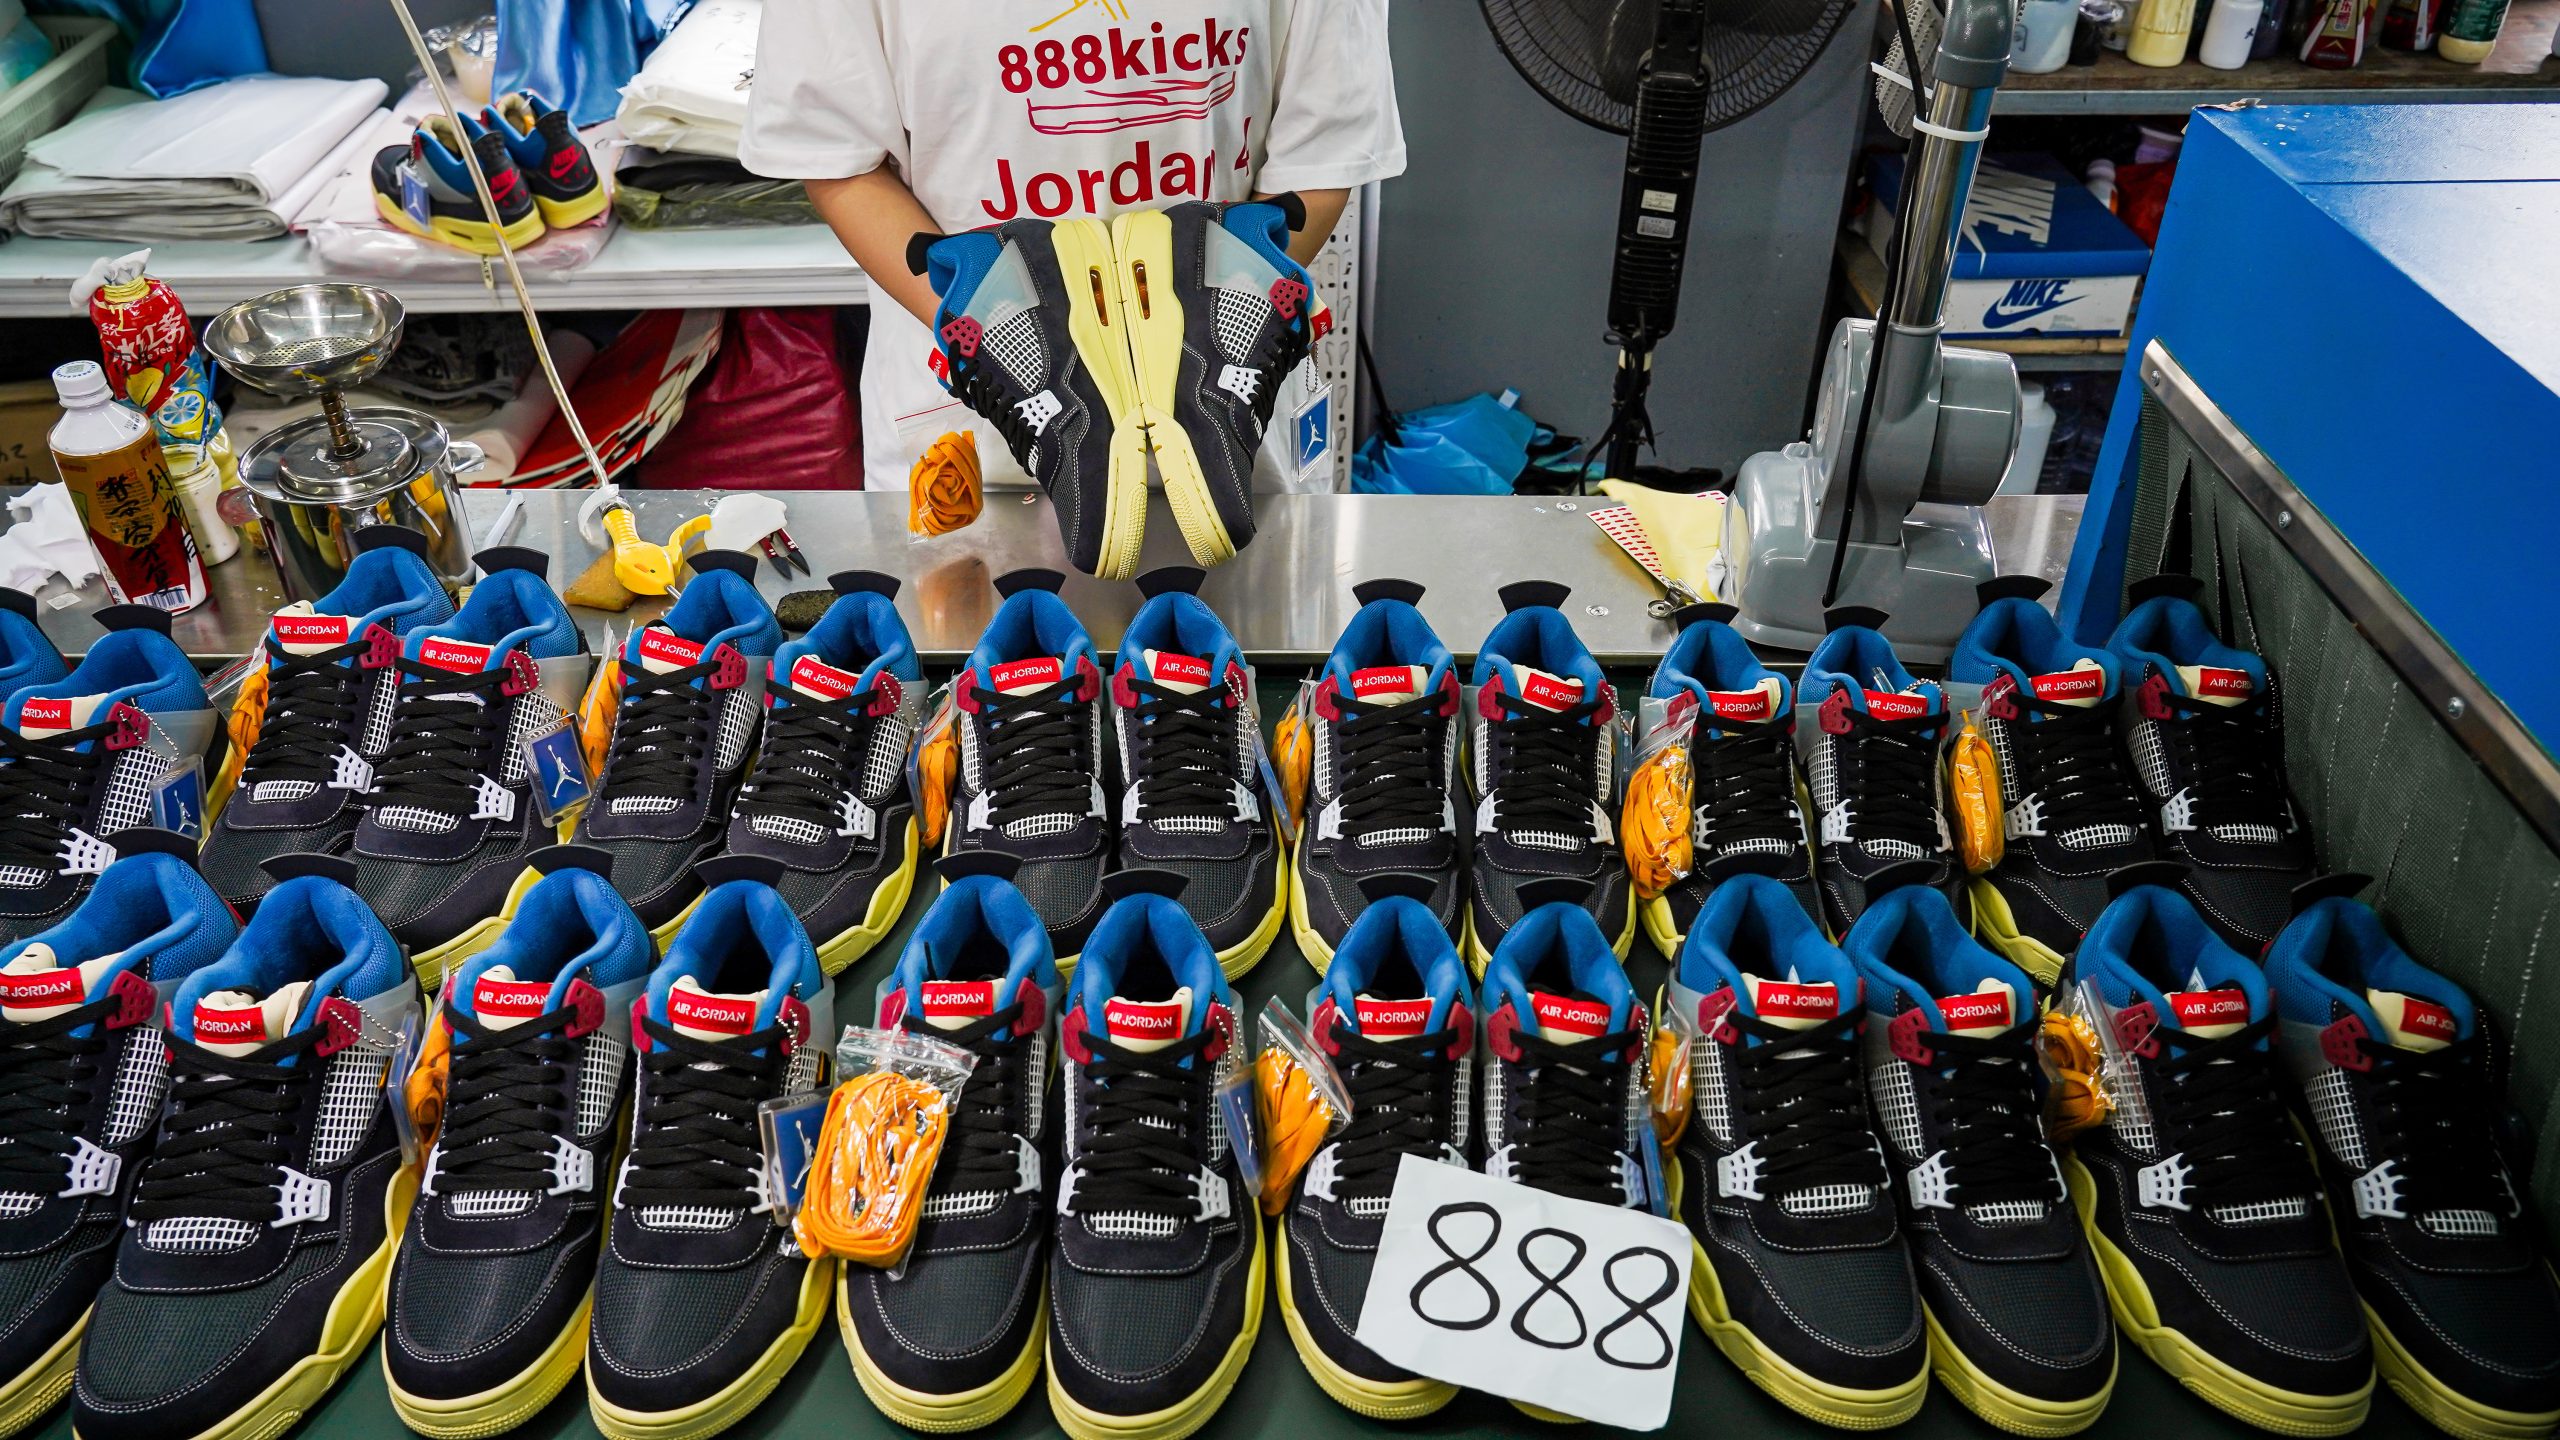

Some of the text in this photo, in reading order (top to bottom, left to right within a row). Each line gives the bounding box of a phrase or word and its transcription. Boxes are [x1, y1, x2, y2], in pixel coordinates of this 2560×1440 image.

[998, 17, 1251, 94] 888kicks
[1234, 116, 1252, 178] 4
[2001, 279, 2071, 307] NIKE
[153, 345, 174, 356] Tea
[279, 625, 340, 635] AIR JORDAN
[646, 639, 661, 650] AIR
[424, 648, 482, 665] AIR JORDAN
[994, 665, 1053, 684] AIR JORDAN
[1162, 662, 1180, 673] AIR
[798, 666, 854, 693] AIR JORDAN
[1364, 675, 1405, 686] JORDAN
[2037, 678, 2096, 692] AIR JORDAN
[2209, 677, 2228, 688] AIR
[1532, 684, 1550, 697] AIR
[1712, 701, 1764, 712] IR JORDAN
[1866, 699, 1923, 715] AIR JORDAN
[11, 980, 71, 998] JORDAN
[478, 990, 494, 1004] AIR
[932, 992, 985, 1005] JORDAN
[1767, 993, 1833, 1008] AIR JORDAN
[674, 1001, 746, 1023] AIR JORDAN
[1540, 1004, 1609, 1026] AIR JORDAN
[1949, 1003, 2002, 1019] JORDAN
[2184, 1003, 2206, 1015] AIR
[1107, 1011, 1173, 1028] AIR JORDAN
[1357, 1010, 1425, 1024] AIR JORDAN
[2416, 1013, 2438, 1027] AIR
[199, 1020, 252, 1033] JORDAN
[1409, 1201, 1680, 1370] 888
